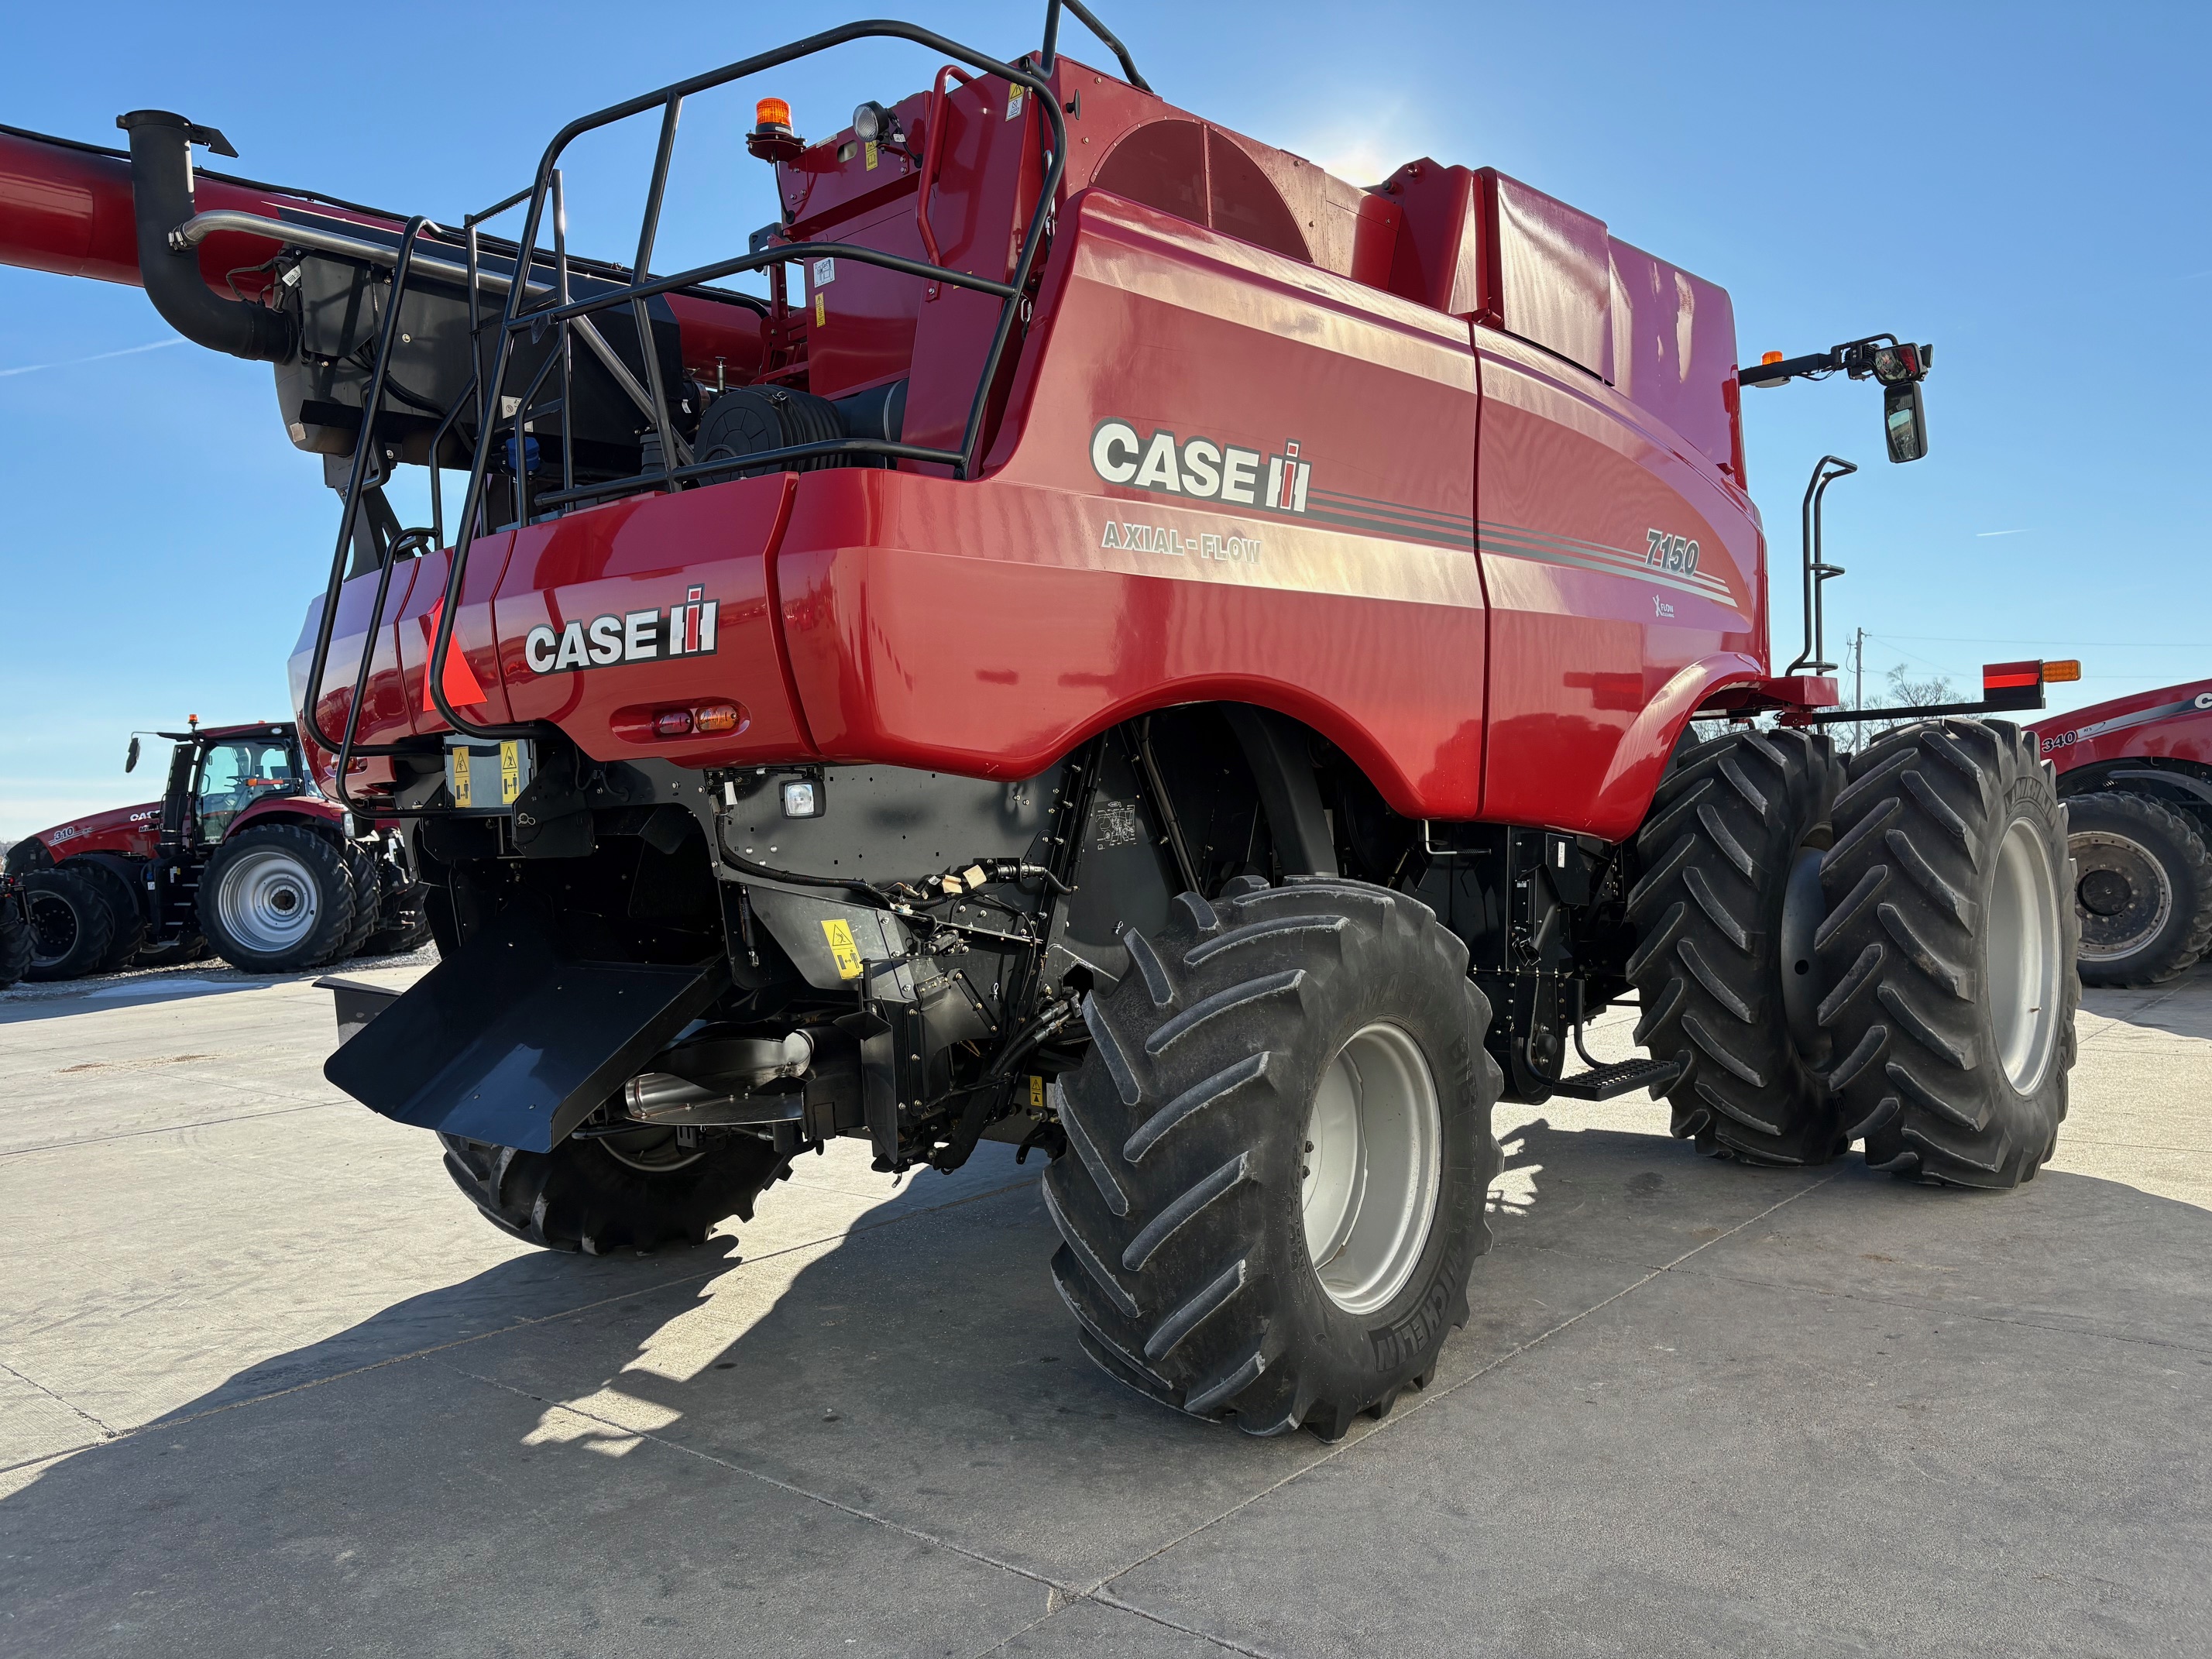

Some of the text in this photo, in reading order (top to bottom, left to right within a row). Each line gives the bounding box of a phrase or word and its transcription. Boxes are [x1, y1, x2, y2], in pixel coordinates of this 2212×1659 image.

[1092, 423, 1260, 504] CASE
[1645, 527, 1700, 577] 7150
[524, 610, 660, 673] CASE
[2042, 730, 2078, 752] 340
[54, 826, 74, 840] 310
[130, 809, 161, 822] CAS
